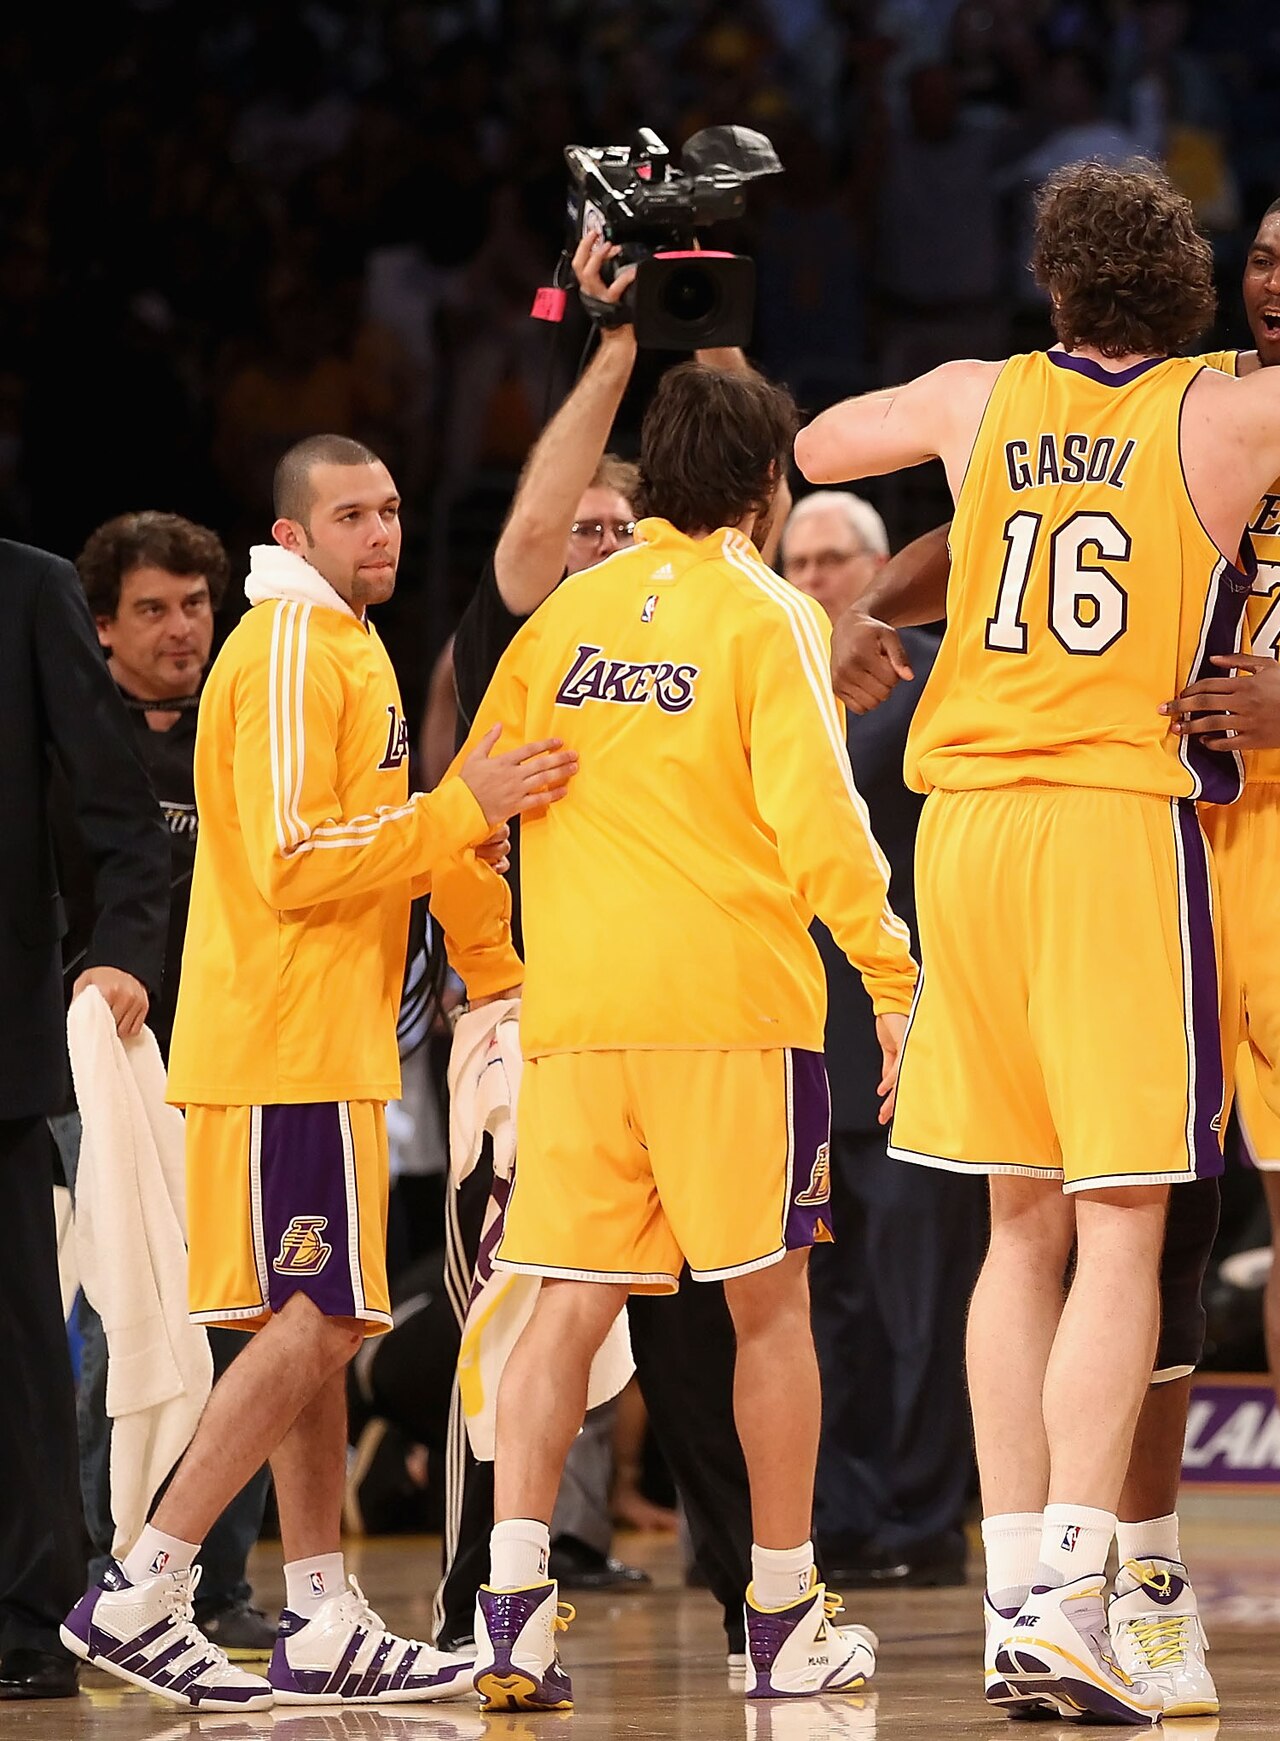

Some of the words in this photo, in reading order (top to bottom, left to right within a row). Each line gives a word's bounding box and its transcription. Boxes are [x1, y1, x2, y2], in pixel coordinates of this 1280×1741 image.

[1004, 433, 1138, 492] GASOL
[984, 509, 1133, 657] 16
[554, 644, 700, 715] LAKERS
